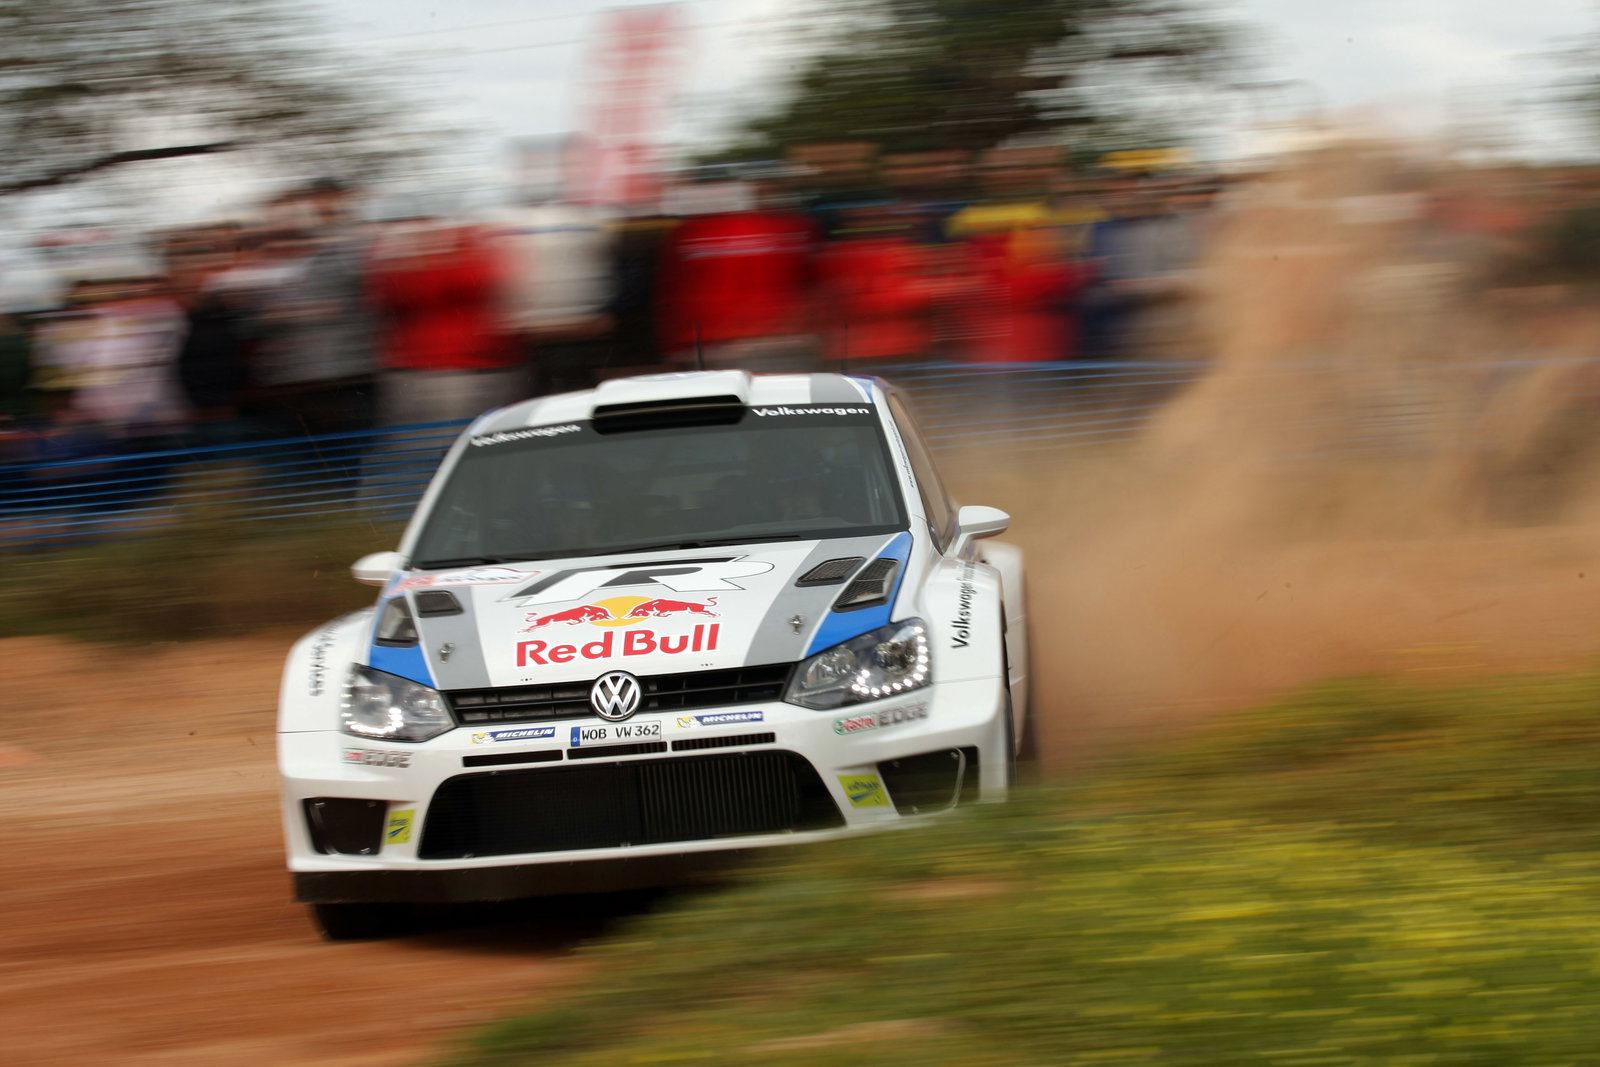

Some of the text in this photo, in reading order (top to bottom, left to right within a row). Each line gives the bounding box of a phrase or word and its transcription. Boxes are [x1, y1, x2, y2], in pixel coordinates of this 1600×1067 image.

[752, 406, 870, 417] Volkswagen
[516, 623, 720, 667] Red Bull
[496, 728, 554, 739] MICHELIN
[581, 728, 607, 741] WOB
[615, 726, 632, 738] VW
[634, 724, 660, 737] 362
